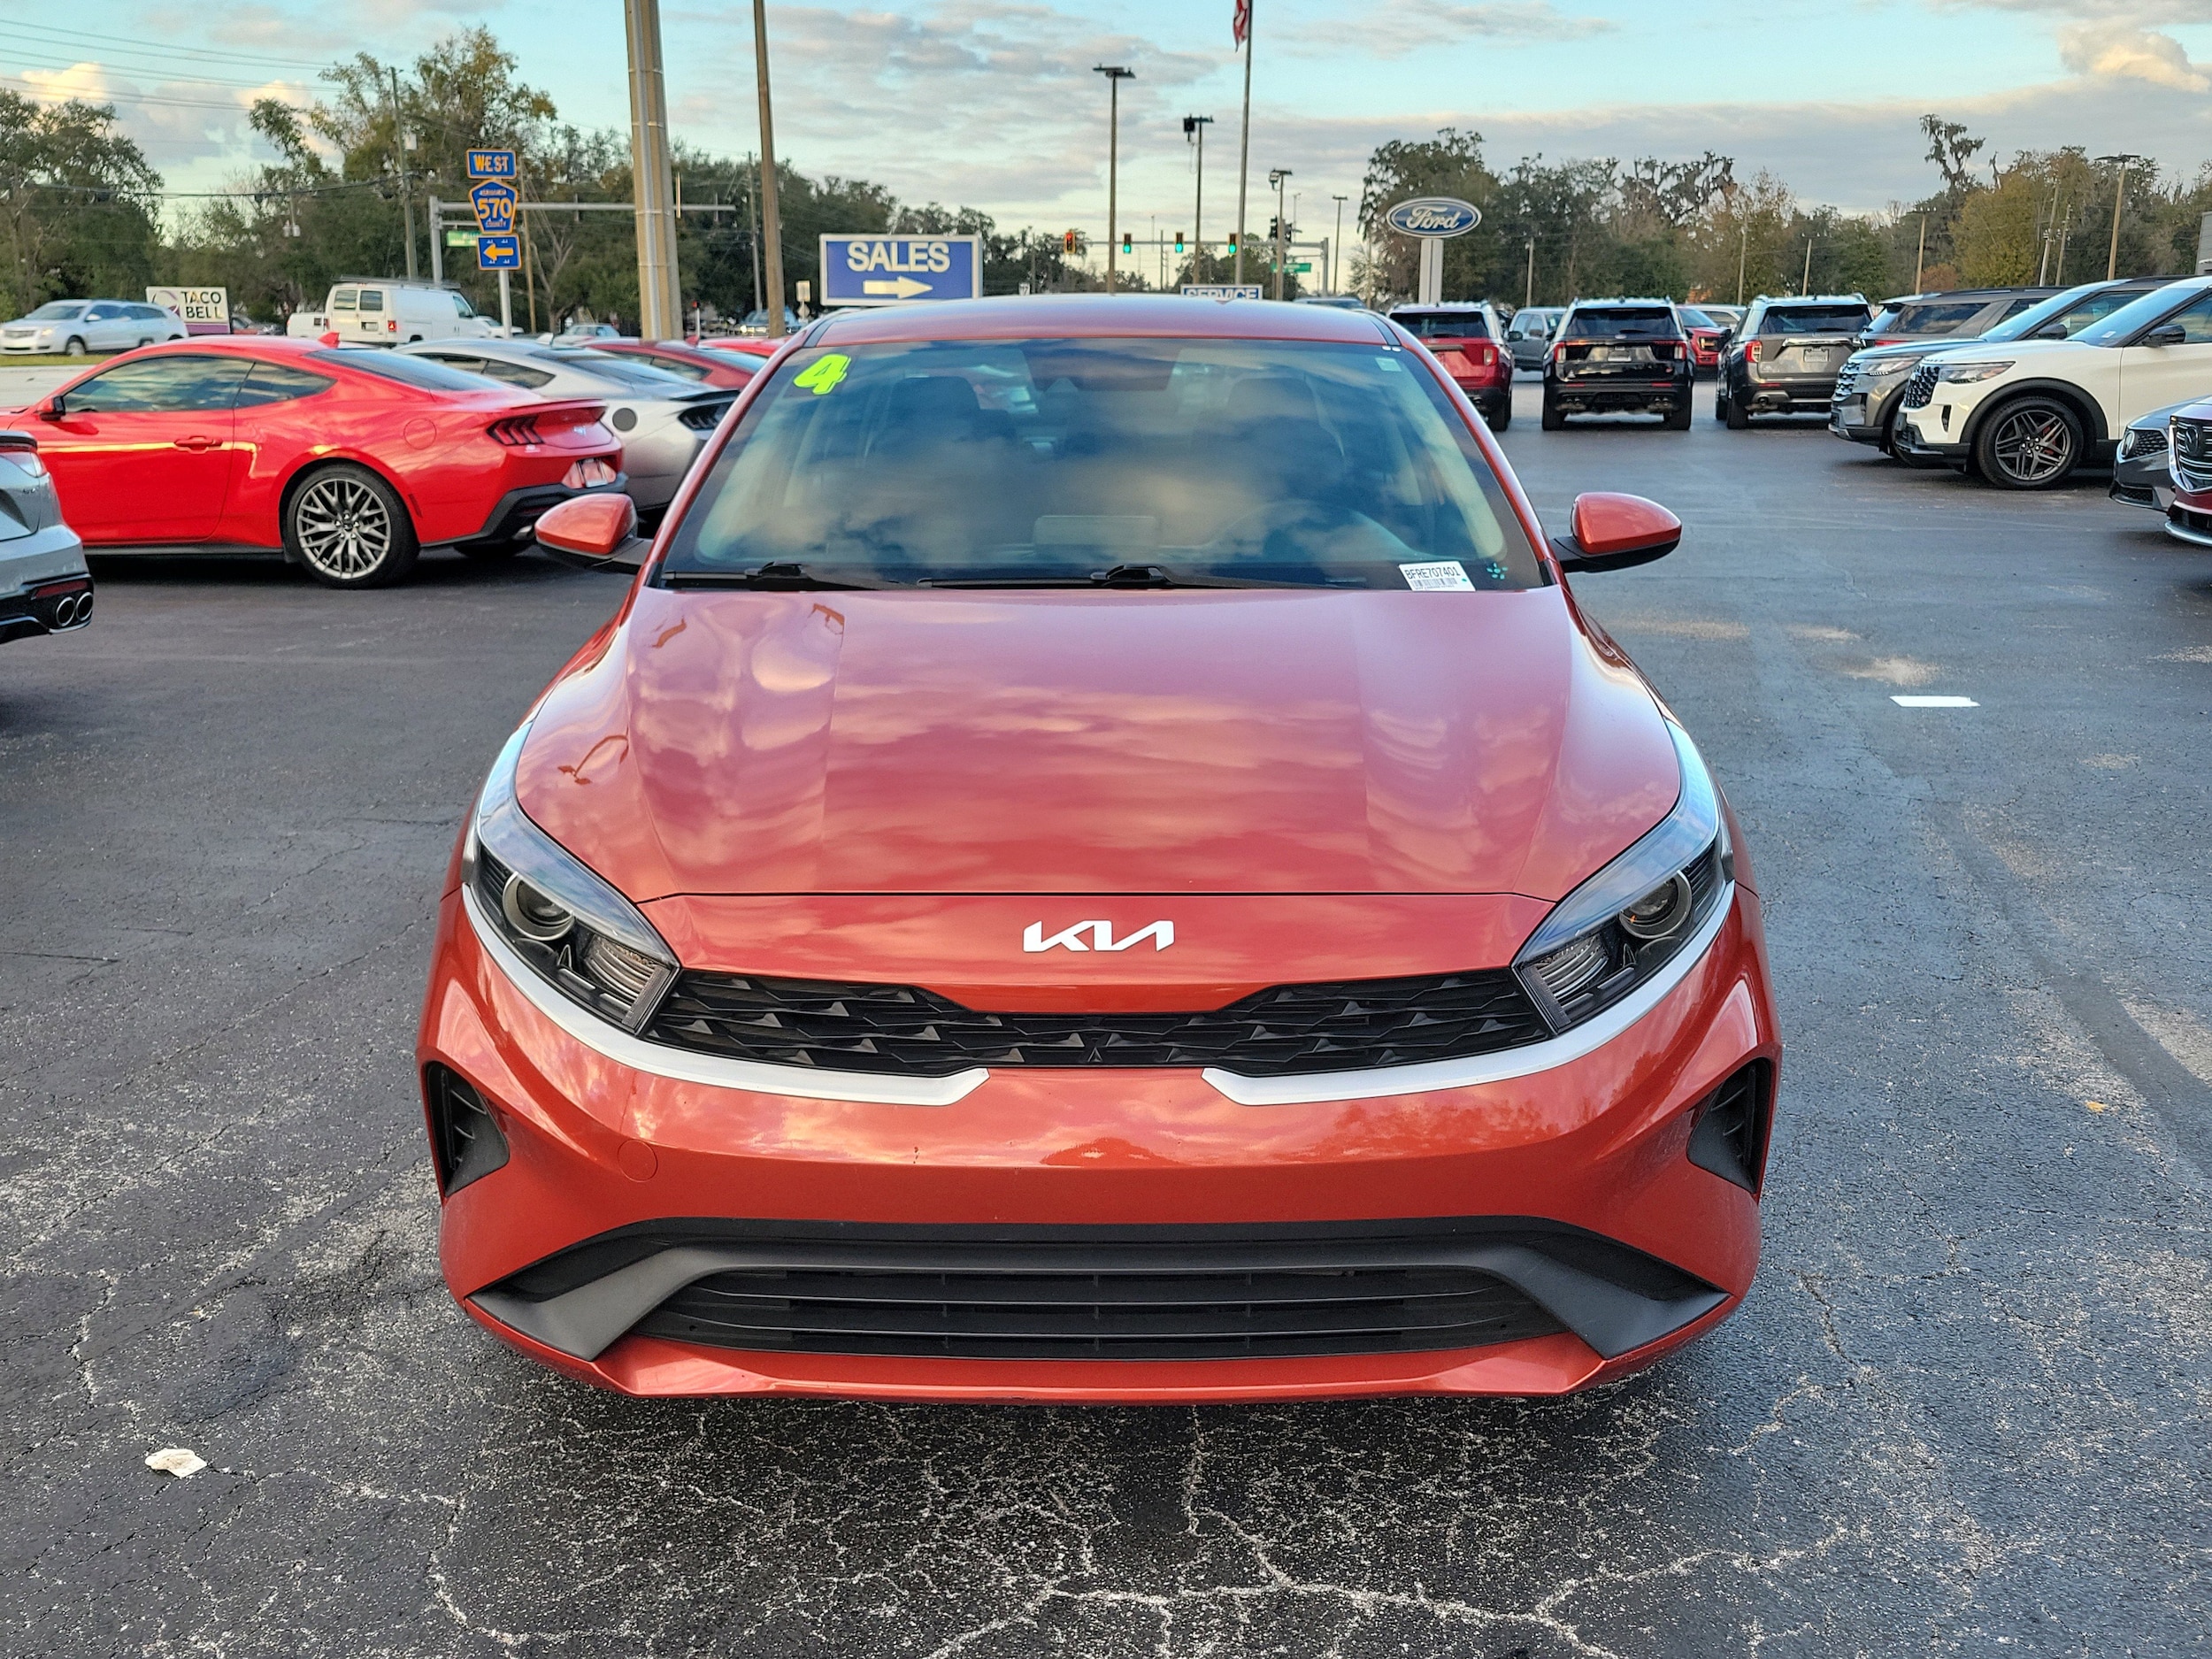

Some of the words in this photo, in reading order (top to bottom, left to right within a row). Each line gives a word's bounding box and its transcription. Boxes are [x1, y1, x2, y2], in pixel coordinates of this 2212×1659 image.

[473, 154, 509, 173] WEST
[477, 197, 513, 219] 570
[1406, 205, 1463, 229] Ford
[847, 242, 952, 273] SALES
[181, 291, 222, 304] TACO
[186, 306, 223, 319] BELL
[794, 353, 851, 396] 4
[1404, 566, 1460, 580] BFRE707401
[1023, 919, 1175, 953] KIA
